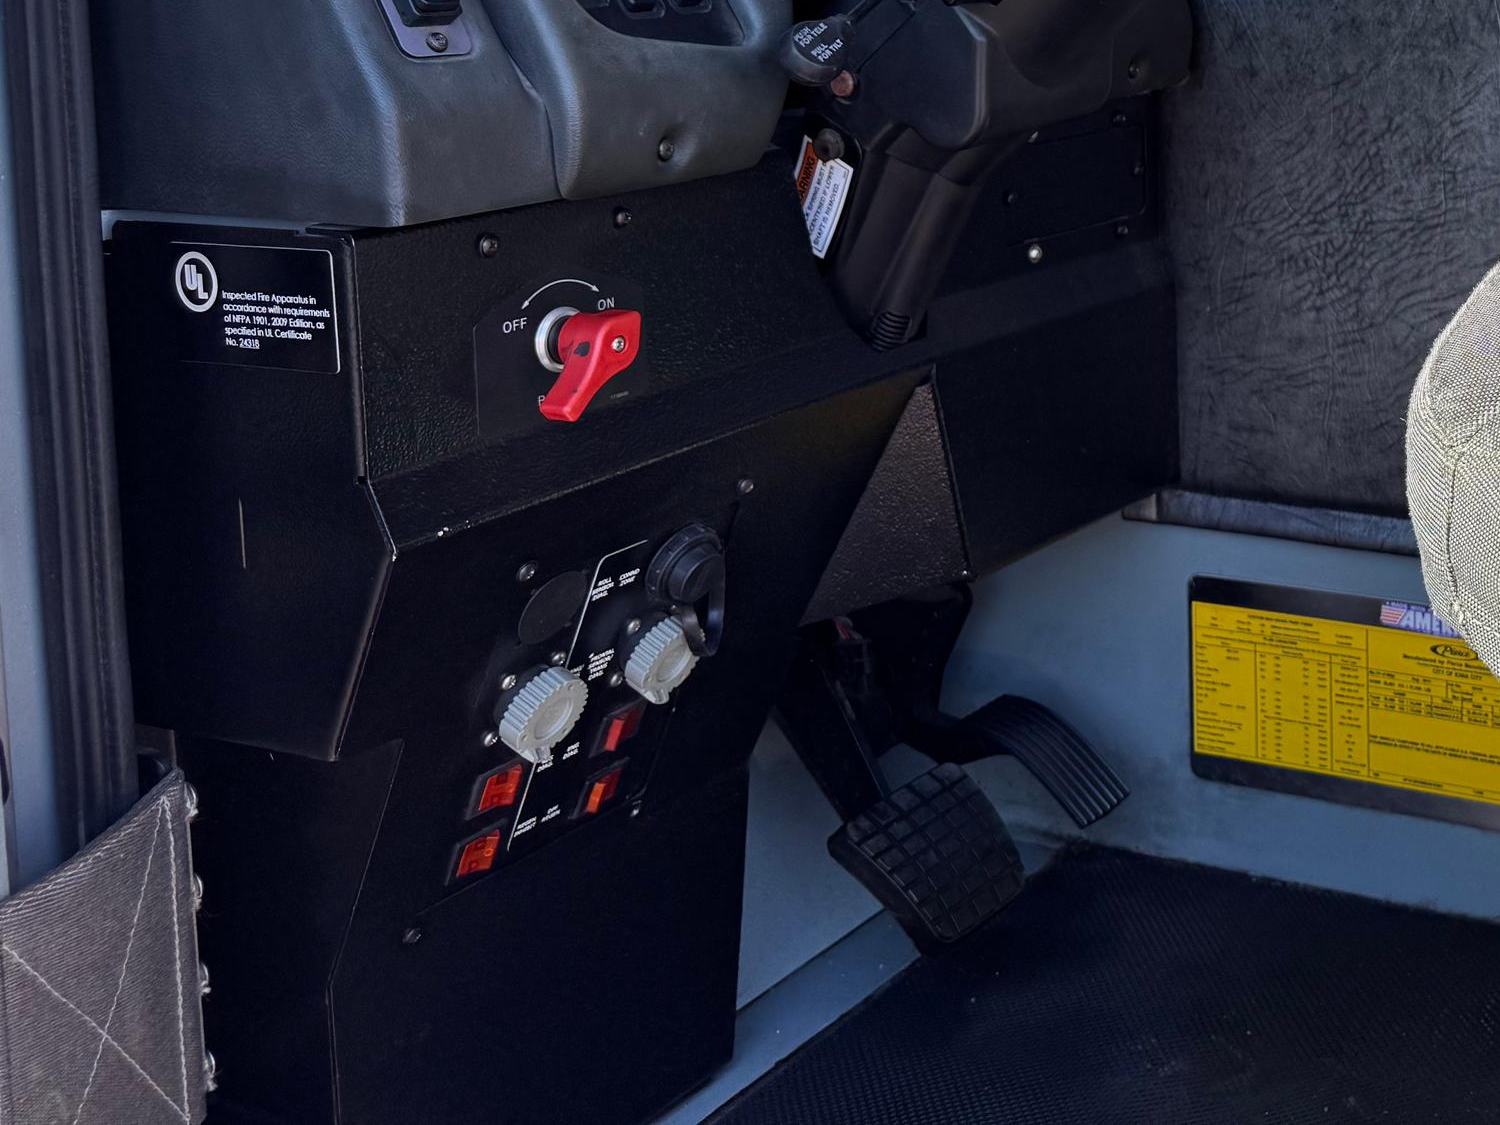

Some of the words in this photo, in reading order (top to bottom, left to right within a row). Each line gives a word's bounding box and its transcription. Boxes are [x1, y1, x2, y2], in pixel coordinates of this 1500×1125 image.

[794, 26, 812, 43] PUSH
[799, 34, 815, 48] FOR
[810, 22, 828, 37] TELE
[811, 43, 828, 57] PULL
[817, 49, 833, 63] FOR
[184, 264, 208, 300] UL
[222, 290, 256, 301] Inspected
[257, 292, 270, 301] Fire
[271, 294, 308, 304] Apparatus
[309, 295, 316, 304] in
[597, 297, 615, 310] ON
[223, 303, 267, 314] accordance
[267, 305, 283, 315] with
[284, 306, 331, 318] requirements
[224, 314, 231, 322] of
[232, 315, 251, 324] NFPA
[271, 317, 288, 327] 2009
[316, 322, 325, 330] as
[502, 317, 528, 334] OFF
[225, 326, 256, 336] specified
[257, 327, 265, 337] in
[264, 328, 274, 338] UL
[274, 329, 313, 340] Certificate
[226, 337, 238, 347] No.
